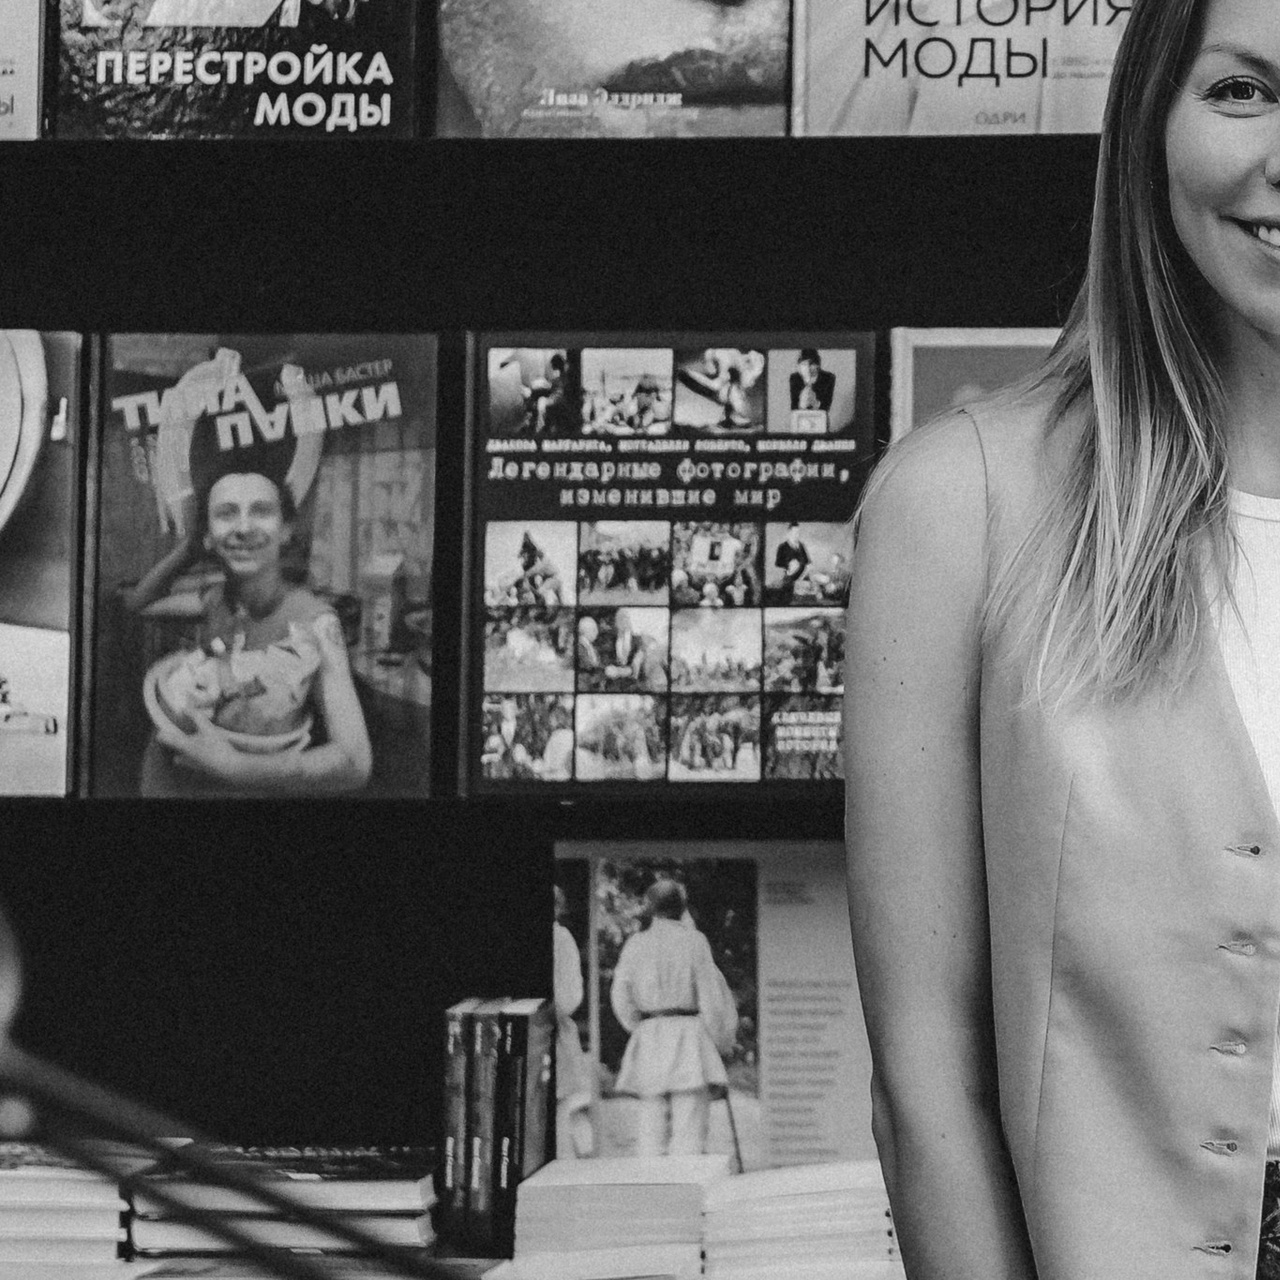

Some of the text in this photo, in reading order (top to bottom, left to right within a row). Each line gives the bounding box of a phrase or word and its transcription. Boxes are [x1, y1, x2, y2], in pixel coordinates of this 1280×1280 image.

[96, 43, 394, 85] ПЕРЕСТРОЙКА
[864, 36, 1048, 87] МОДЫ
[253, 92, 392, 132] МОДЫ
[487, 456, 850, 484] Легендарные фотографии,
[559, 487, 782, 510] изменившие мир
